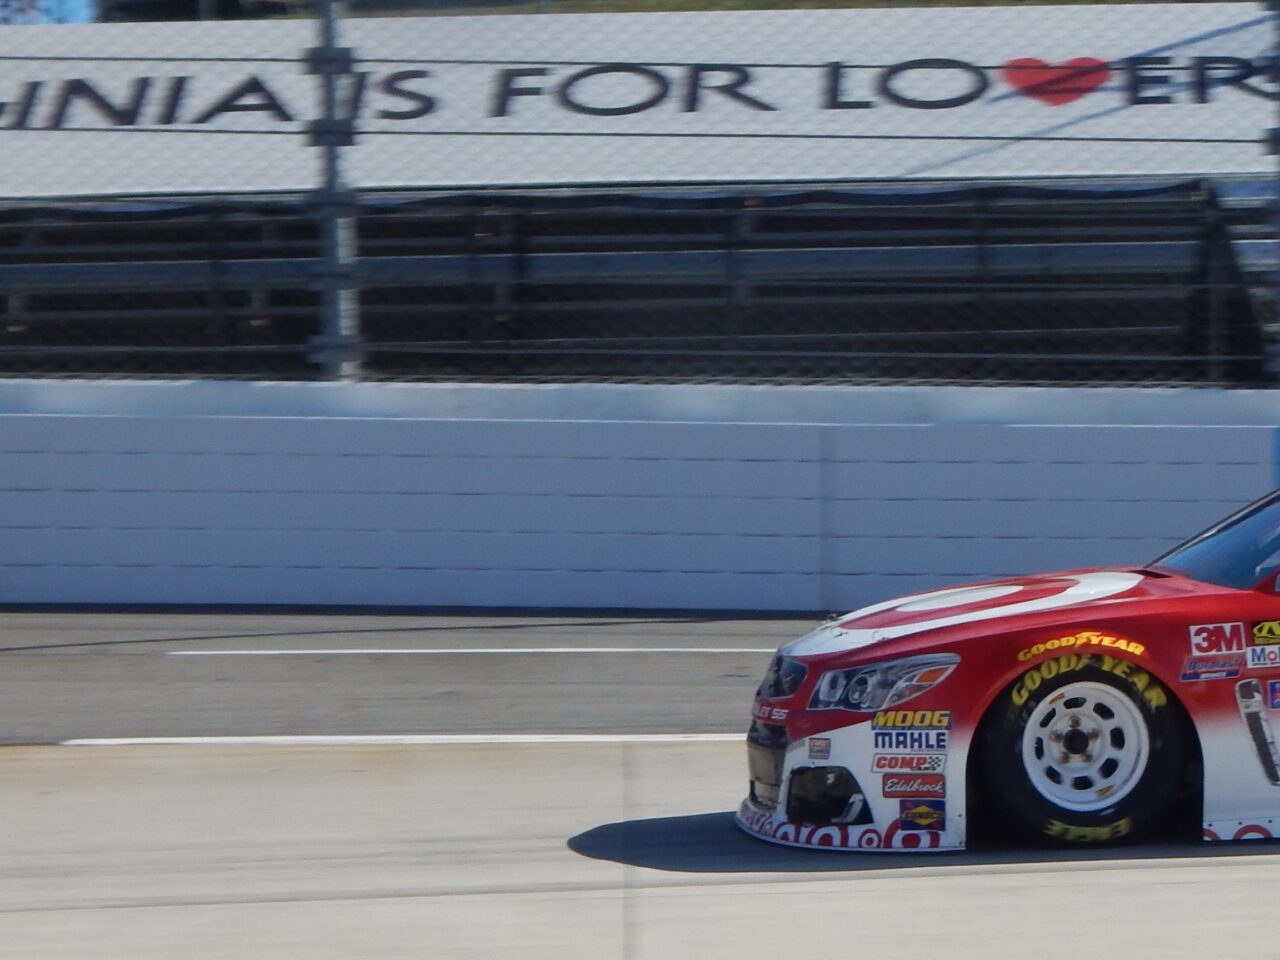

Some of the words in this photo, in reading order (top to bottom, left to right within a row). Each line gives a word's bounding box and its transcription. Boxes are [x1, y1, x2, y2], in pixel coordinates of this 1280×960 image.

[0, 76, 294, 128] INIA
[486, 62, 777, 118] FOR
[1017, 631, 1145, 662] GOODYEAR
[1195, 625, 1241, 653] 3M
[873, 711, 951, 727] MOOG
[874, 732, 946, 748] MAHLE
[875, 756, 929, 768] COMP
[885, 778, 945, 792] Edelbrock
